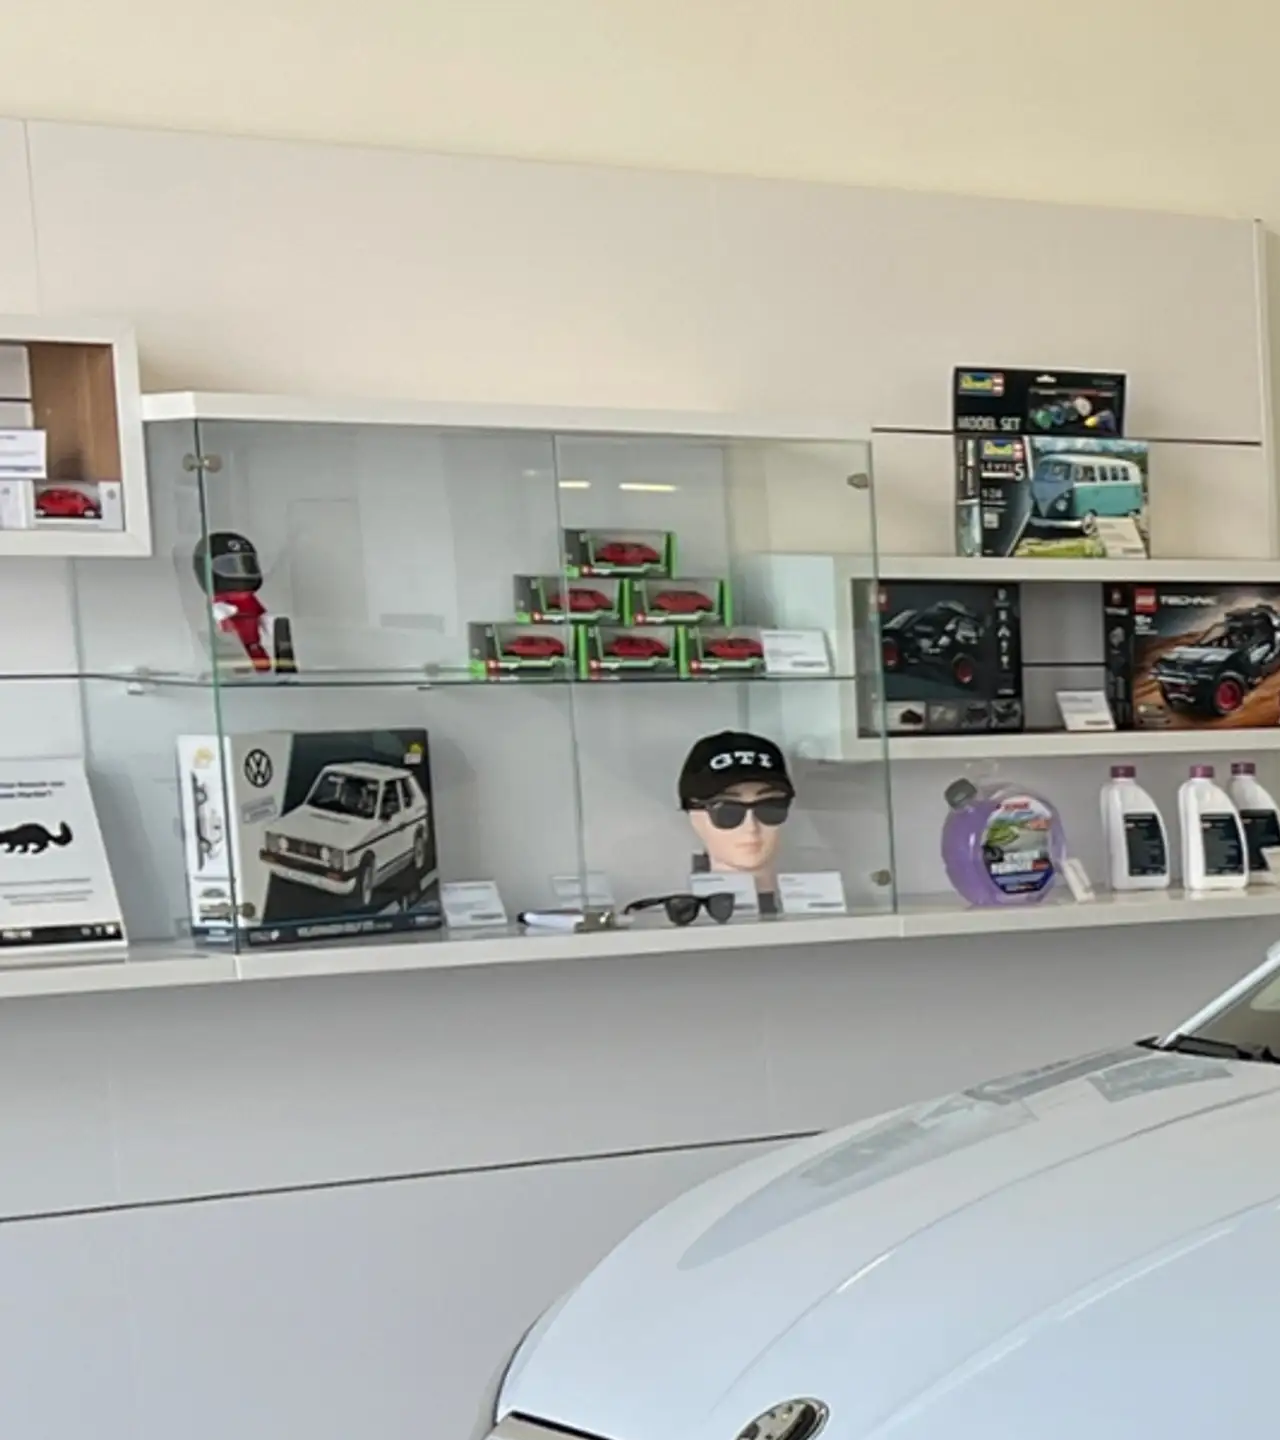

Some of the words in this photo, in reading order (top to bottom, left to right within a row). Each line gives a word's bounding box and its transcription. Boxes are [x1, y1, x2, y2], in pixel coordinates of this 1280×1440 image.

[958, 417, 997, 431] MODEL
[1001, 417, 1021, 431] SET
[1014, 463, 1025, 481] 5
[710, 751, 773, 770] GTI
